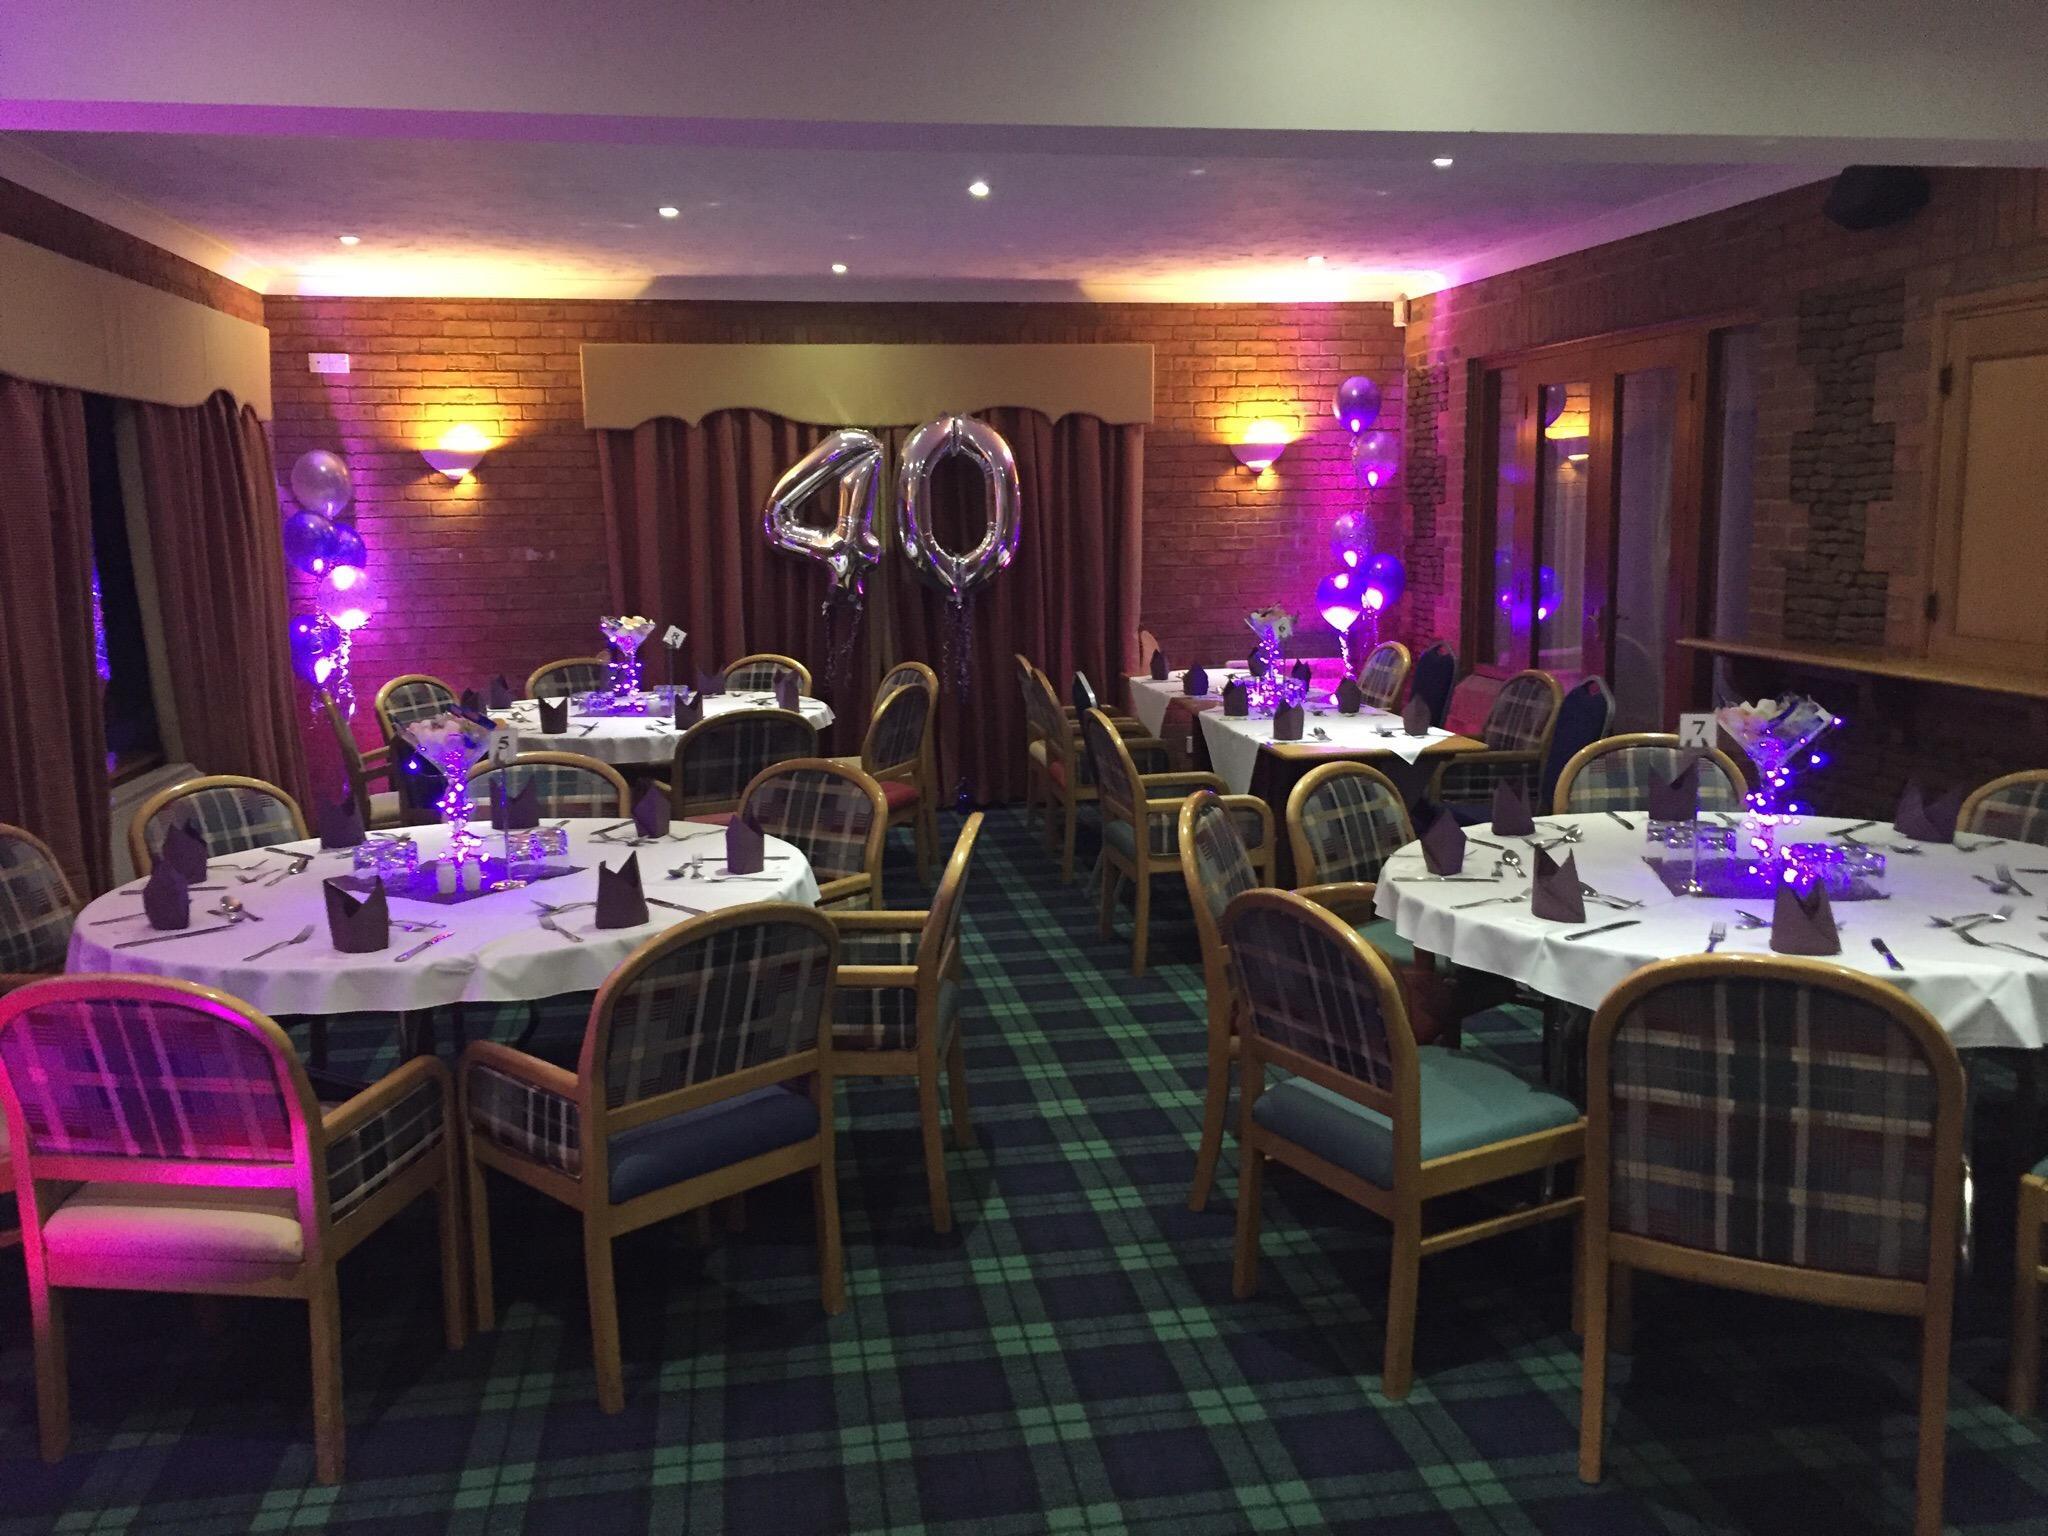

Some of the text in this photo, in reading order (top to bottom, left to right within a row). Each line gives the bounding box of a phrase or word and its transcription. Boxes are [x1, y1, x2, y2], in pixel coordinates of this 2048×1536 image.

[763, 416, 1021, 594] 40
[1693, 721, 1706, 735] 7
[498, 736, 509, 750] 5
